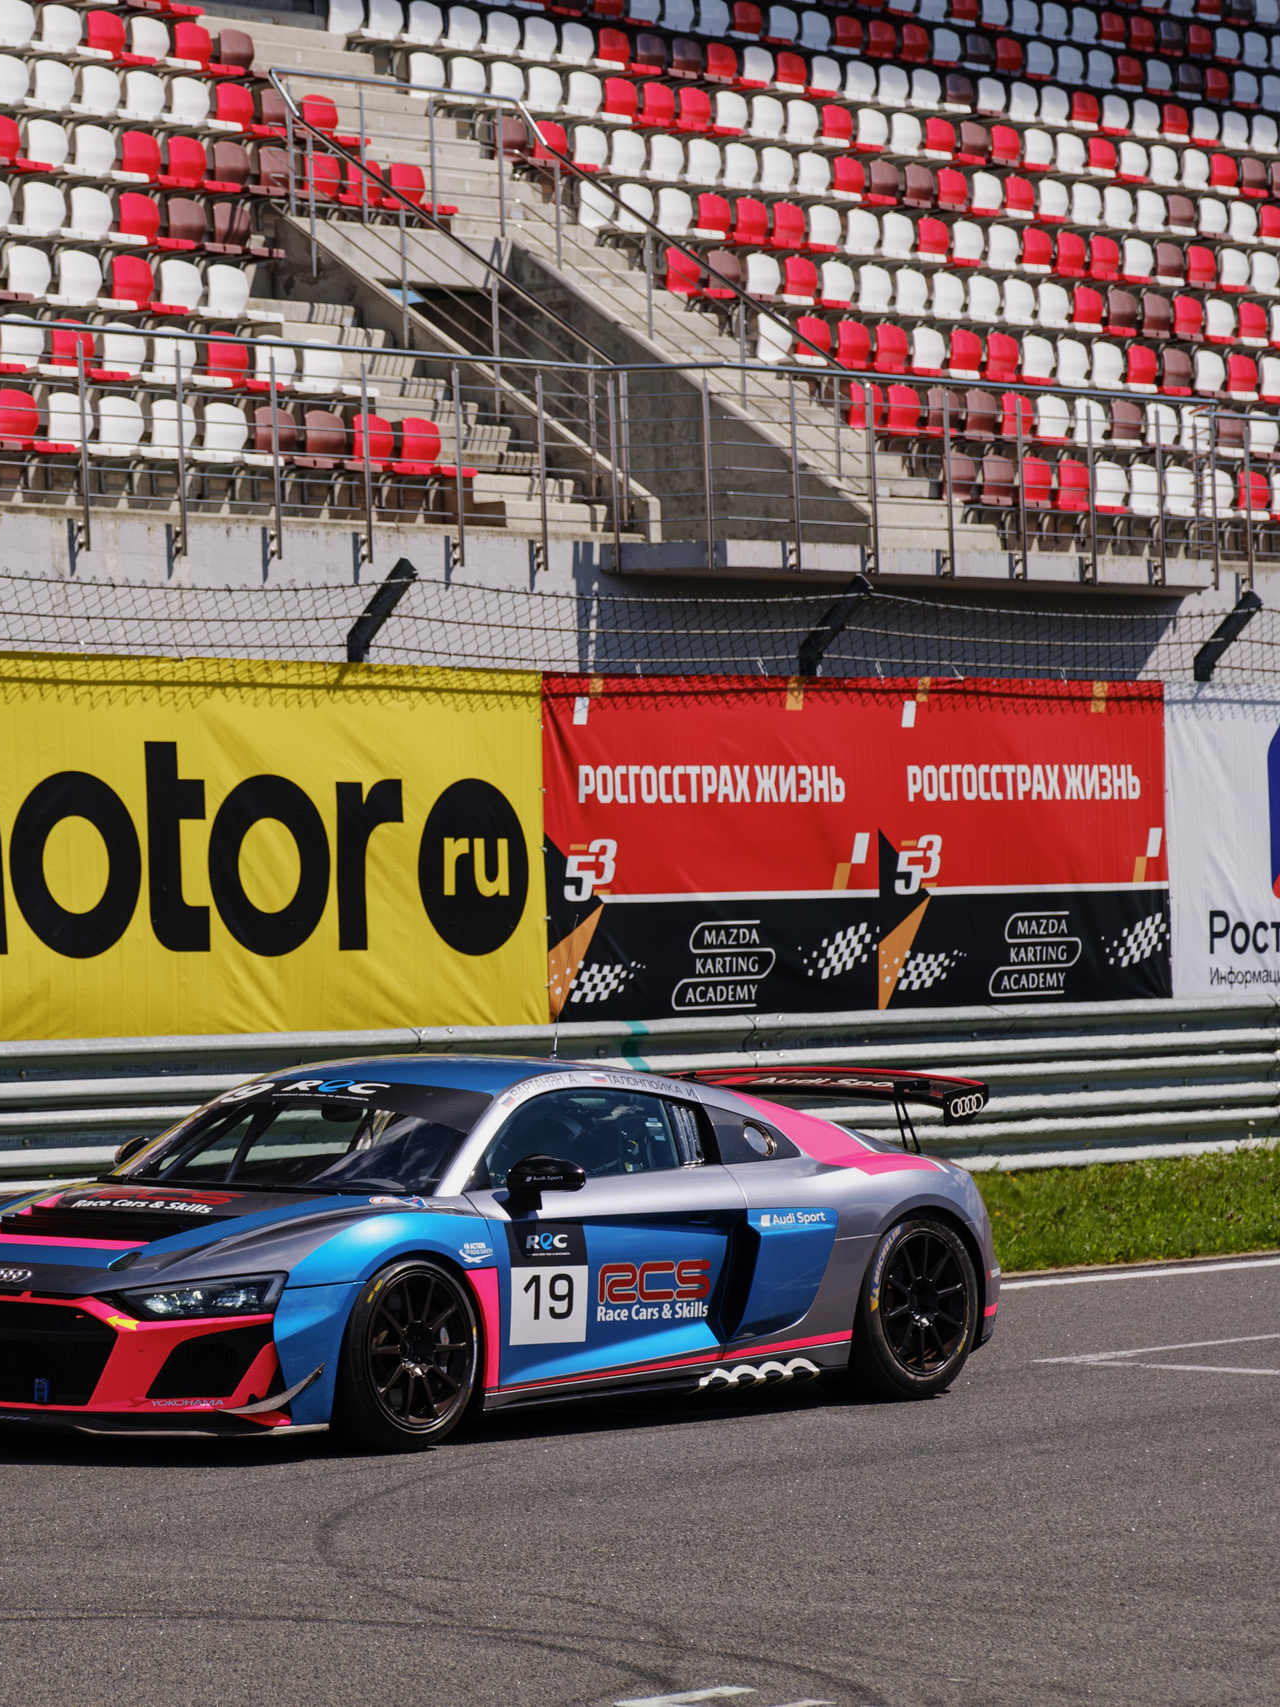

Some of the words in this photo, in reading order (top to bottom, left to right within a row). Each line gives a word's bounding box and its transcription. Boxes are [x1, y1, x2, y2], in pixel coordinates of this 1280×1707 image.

[578, 765, 751, 803] РОСГОССТРАХ
[754, 765, 846, 803] ЖИЗНЬ
[907, 763, 1062, 802] РОСГОССТРАХ
[1063, 763, 1141, 800] ЖИЗНЬ
[443, 836, 510, 898] ru
[564, 838, 618, 902] 53
[894, 834, 943, 895] 53
[703, 928, 760, 945] MAZDA
[1017, 919, 1068, 935] MAZDA
[1010, 945, 1067, 963] KARTING
[695, 956, 759, 975] KARTING
[1001, 972, 1066, 990] ACADEMY
[1210, 966, 1280, 990] Информац
[685, 984, 758, 1003] ACADEMY
[510, 1074, 566, 1100] ВАРТАНЯН
[605, 1074, 684, 1095] ТАЛОНПОЙКА
[749, 1077, 832, 1085] Audi
[830, 1078, 895, 1089] Spo
[71, 1199, 111, 1208] Race
[112, 1199, 148, 1208] Cars
[148, 1200, 165, 1209] &
[164, 1201, 213, 1214] Skills
[773, 1213, 796, 1225] Audi
[797, 1212, 826, 1225] Sport
[874, 1227, 902, 1287] MICHELIN
[598, 1259, 711, 1305] RCS
[523, 1273, 574, 1321] 19
[596, 1306, 629, 1322] Race
[631, 1304, 659, 1320] Cars
[661, 1303, 672, 1319] &
[674, 1301, 709, 1319] Skills
